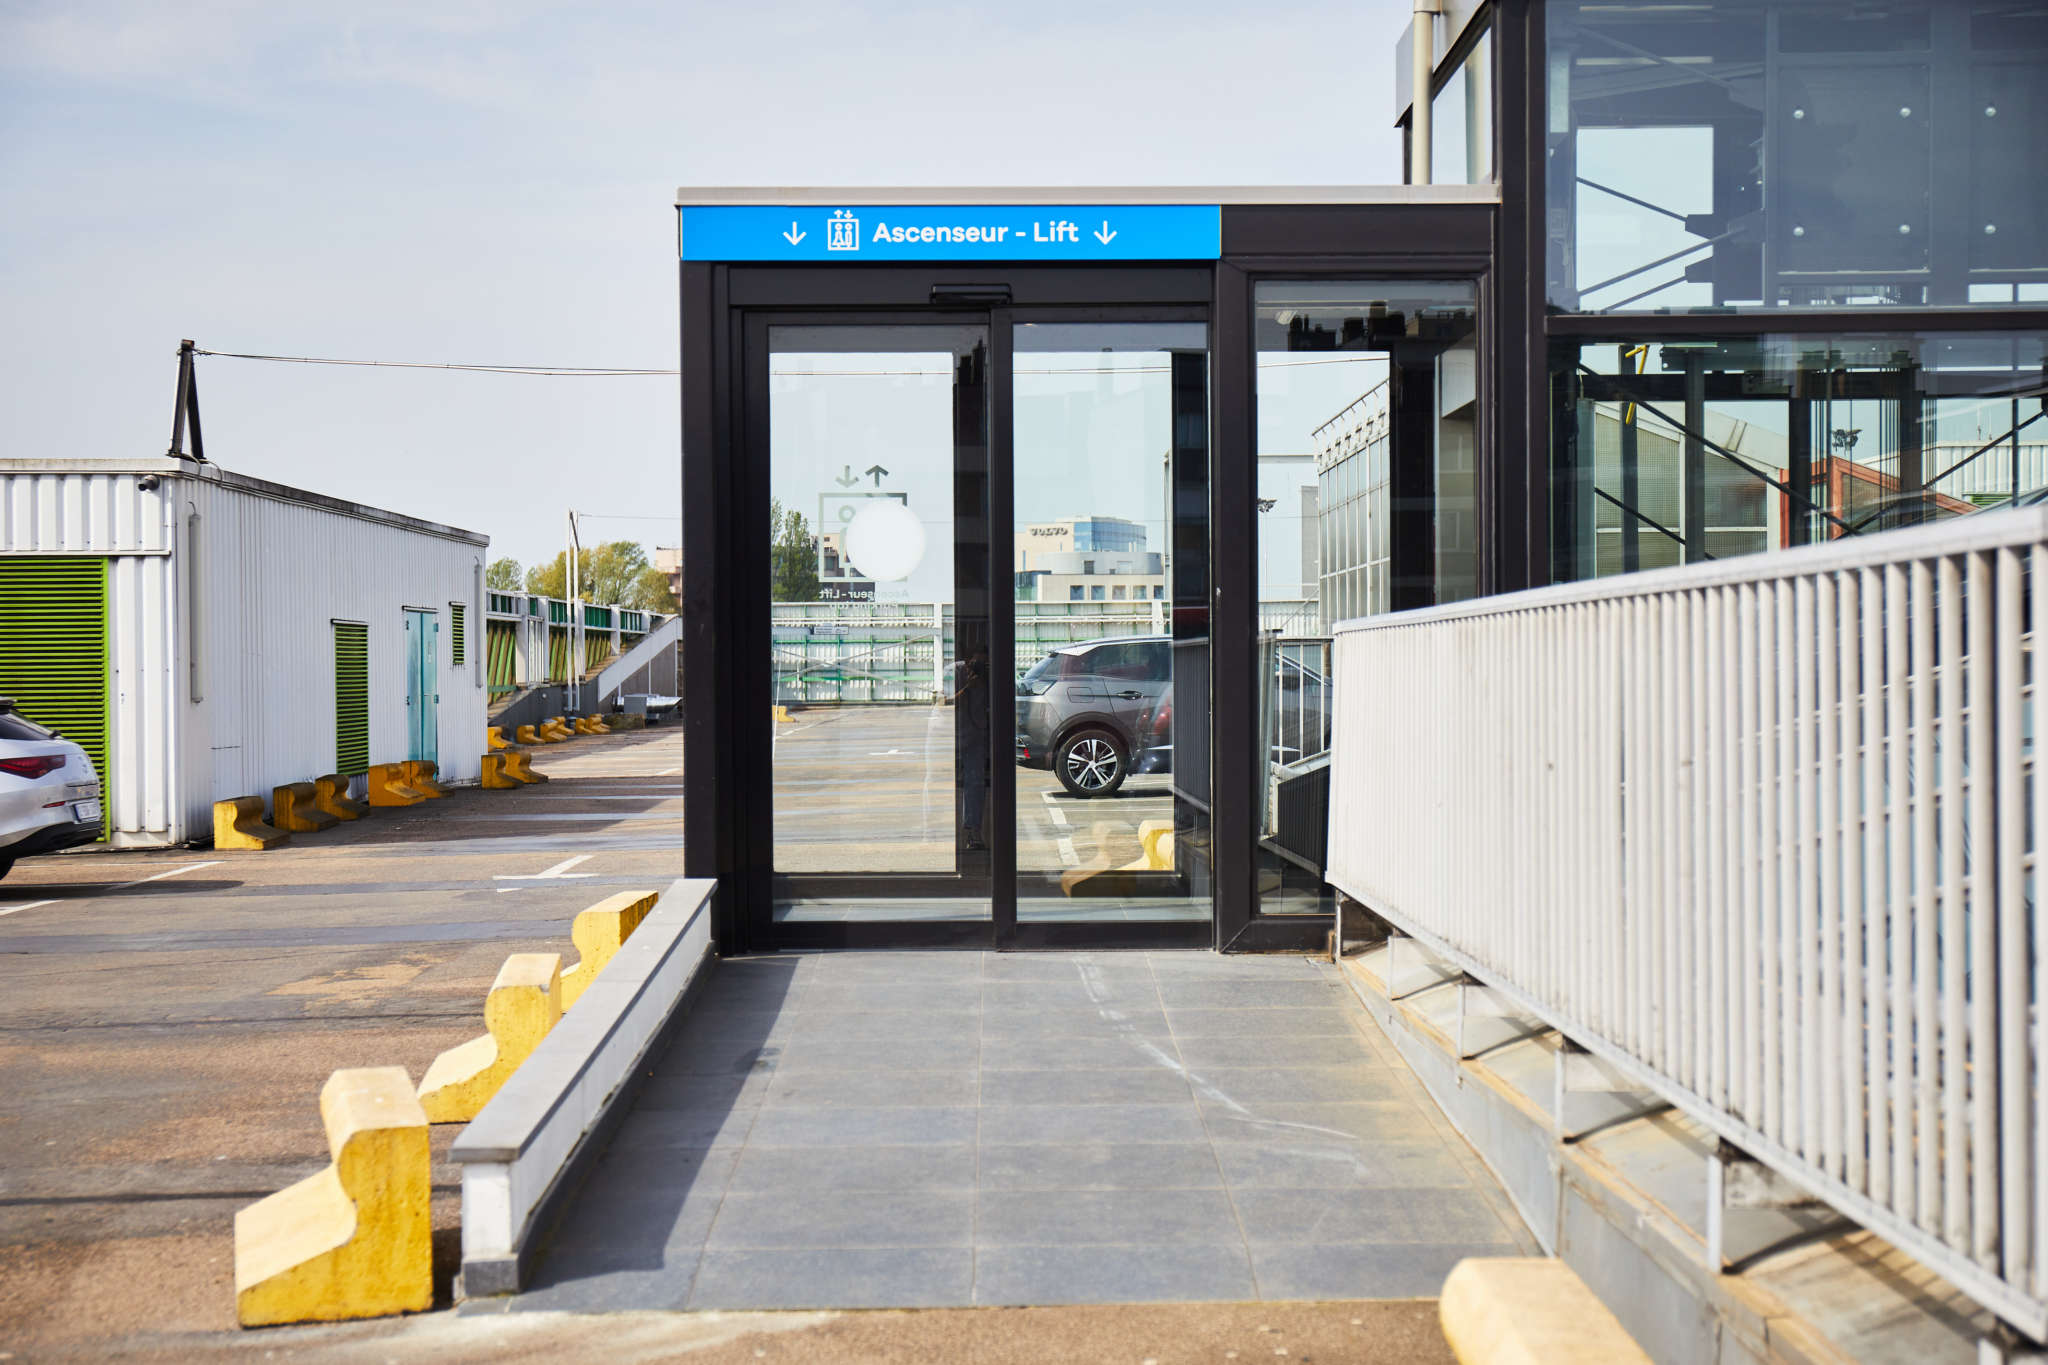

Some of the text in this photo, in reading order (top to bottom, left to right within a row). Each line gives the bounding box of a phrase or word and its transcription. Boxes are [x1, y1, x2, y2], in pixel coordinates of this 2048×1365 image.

[873, 223, 1008, 242] Ascenseur
[1034, 221, 1079, 242] Lift
[1030, 527, 1068, 536] VOLVO
